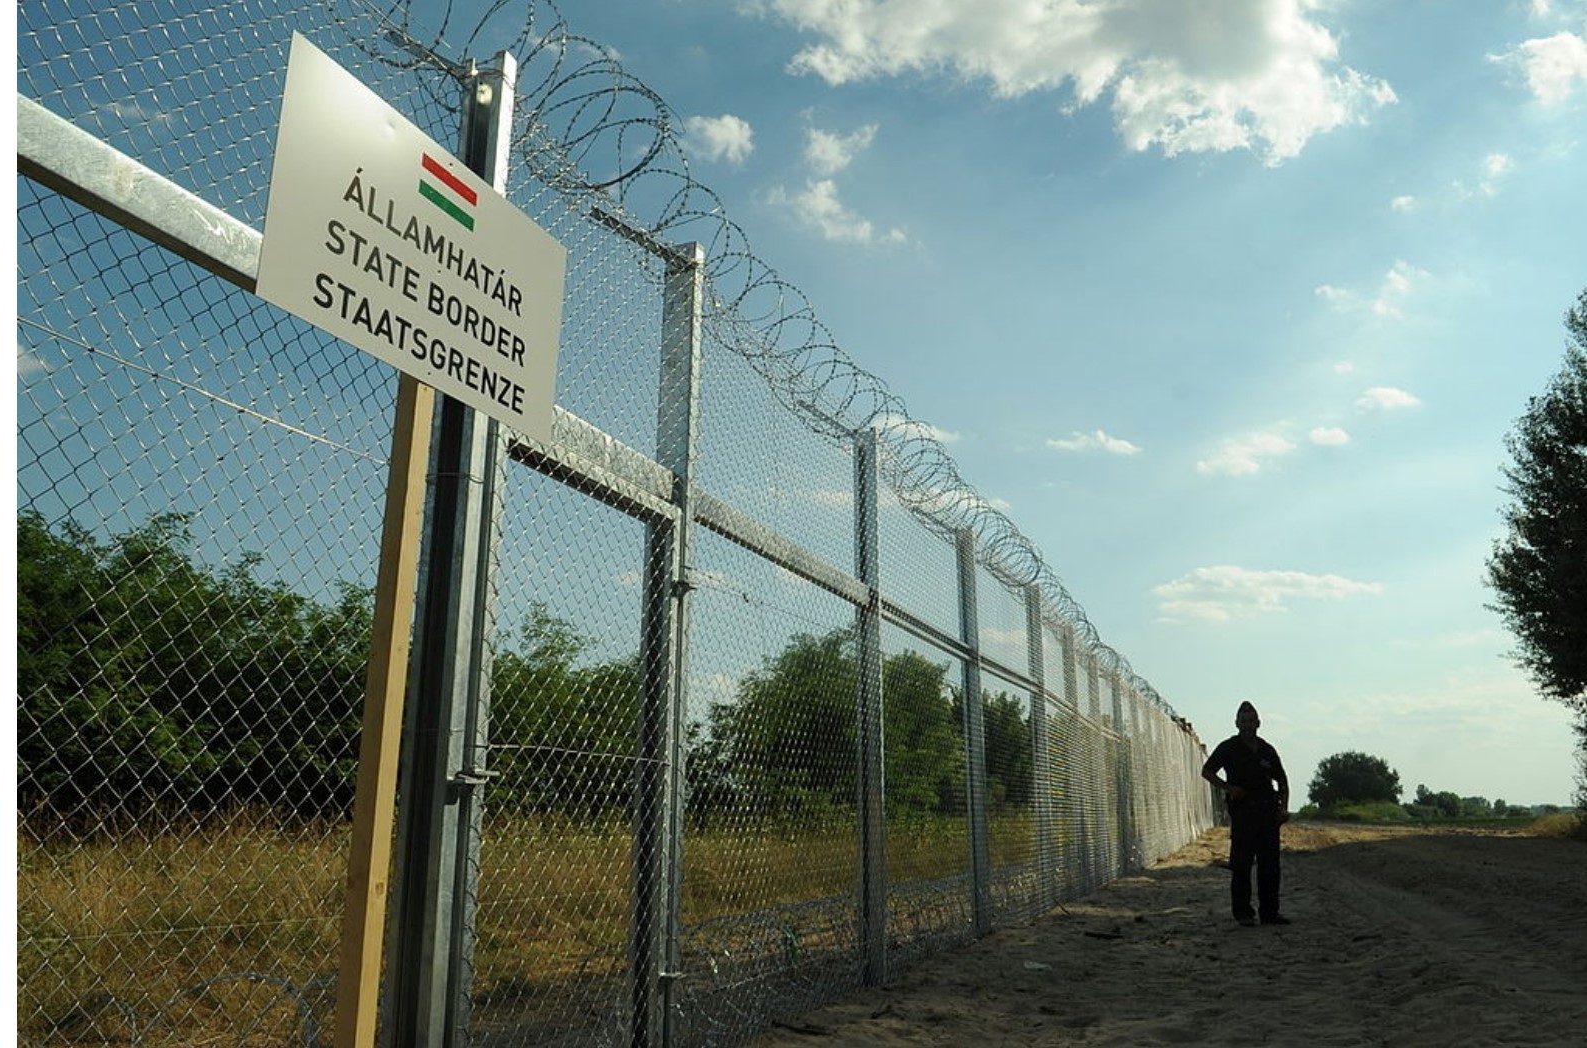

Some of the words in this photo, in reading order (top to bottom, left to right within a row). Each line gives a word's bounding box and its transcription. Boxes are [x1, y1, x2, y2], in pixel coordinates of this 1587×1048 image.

[325, 220, 420, 302] STATE
[428, 281, 526, 367] BORDER
[342, 168, 523, 317] ÁLLAMHATÁR
[313, 272, 526, 416] STAATSGRENZE
